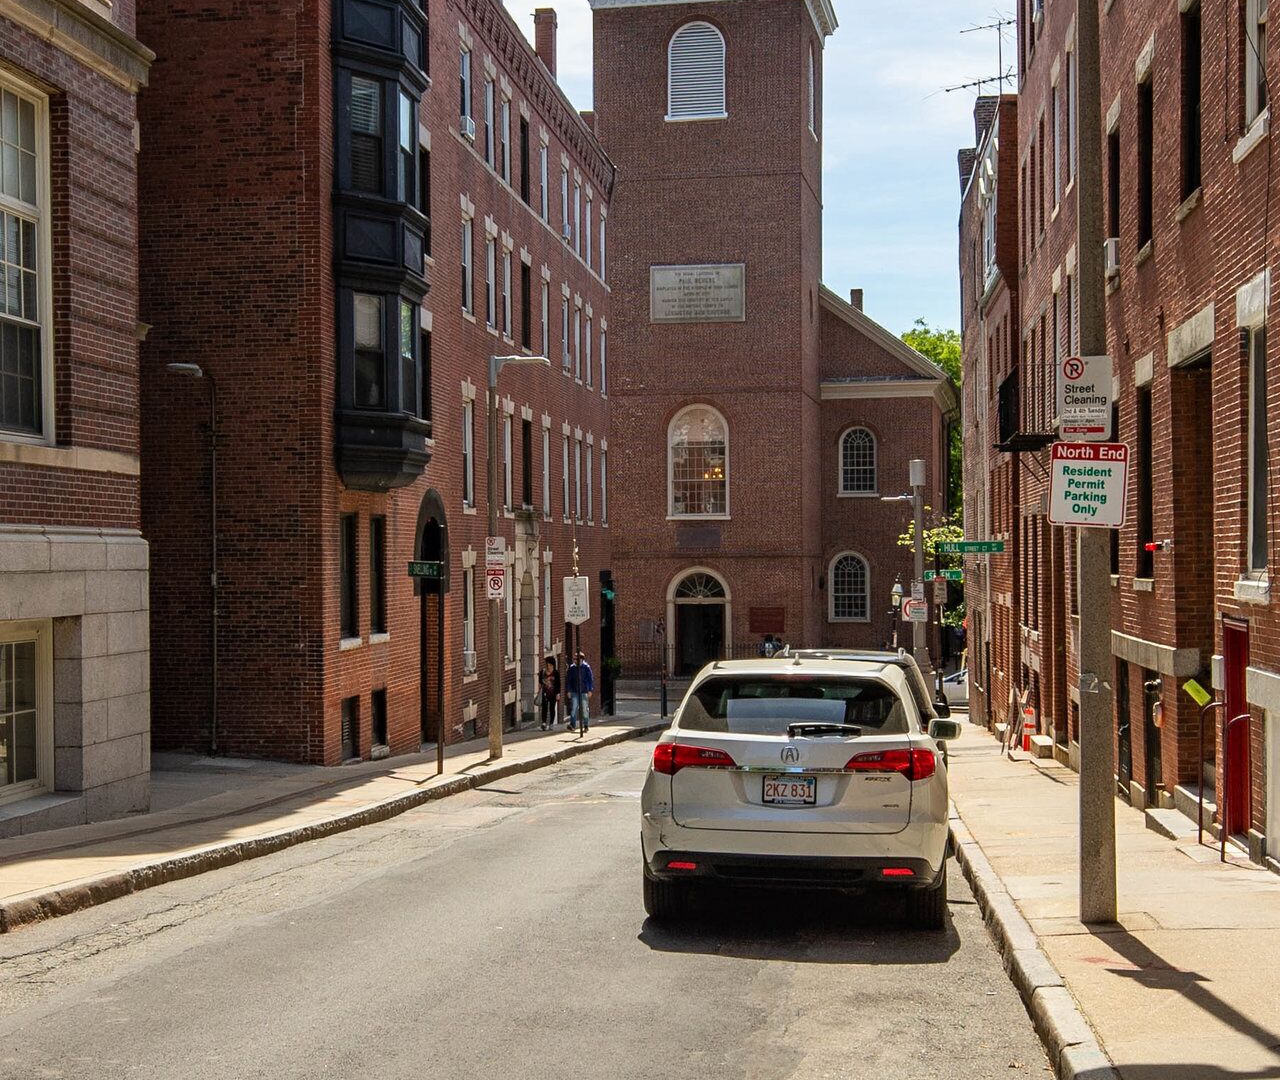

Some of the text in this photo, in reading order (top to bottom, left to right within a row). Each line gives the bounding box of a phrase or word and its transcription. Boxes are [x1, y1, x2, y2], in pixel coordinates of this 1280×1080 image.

[1064, 384, 1095, 394] Street
[1064, 394, 1107, 406] Cleaning
[1057, 445, 1125, 460] North End
[1062, 465, 1112, 477] Resident
[1068, 478, 1105, 489] Permit
[1064, 490, 1107, 505] Parking
[1072, 503, 1098, 517] Only
[943, 543, 960, 552] HULL
[765, 783, 813, 798] 2KZ 831
